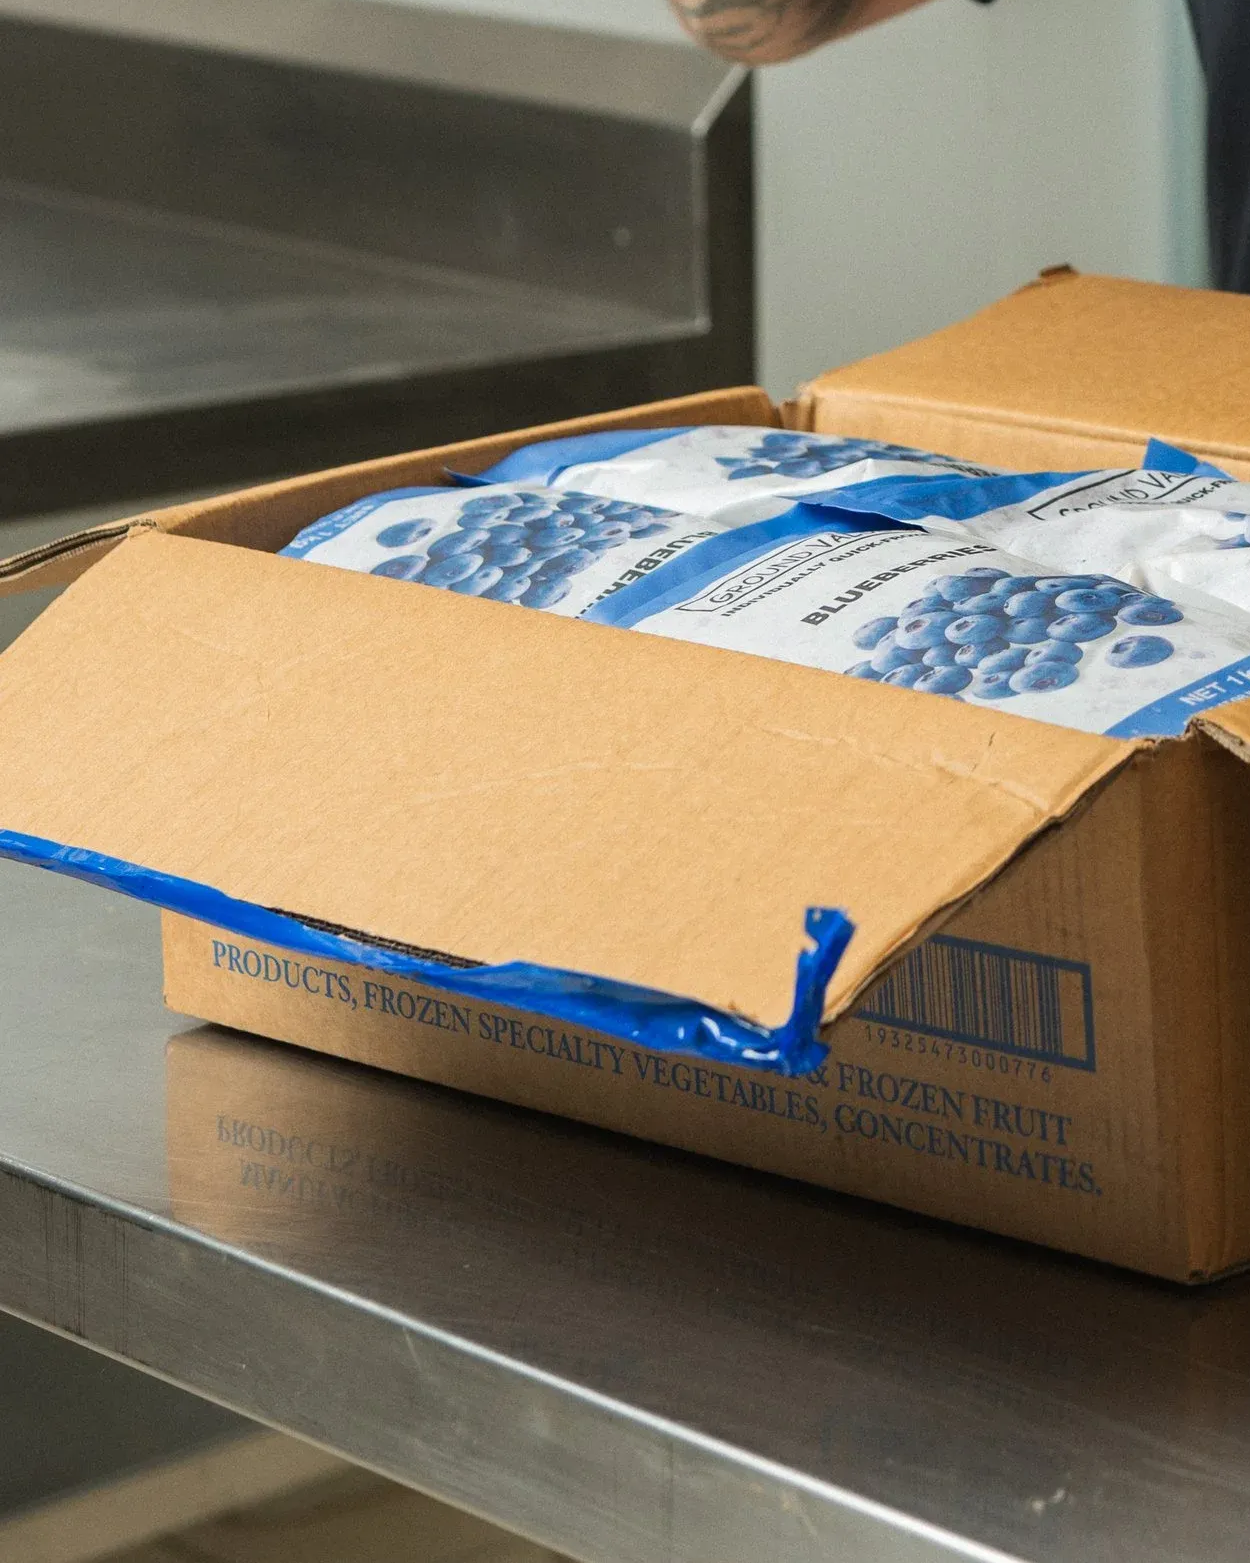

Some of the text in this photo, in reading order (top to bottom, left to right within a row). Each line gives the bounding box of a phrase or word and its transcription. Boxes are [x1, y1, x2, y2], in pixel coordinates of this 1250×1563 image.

[709, 550, 813, 604] GROUND
[721, 561, 826, 618] INDIVIDUALLY
[801, 544, 997, 626] BLUEBERRIES
[1179, 681, 1227, 706] NET
[1226, 675, 1244, 685] 1
[212, 940, 1103, 1195] PRODUCTS, FROZEN SPECIALTY VEGETABLES, CONCENTRATES.
[864, 1024, 1052, 1084] 19325473000776
[836, 1060, 966, 1121] FROZEN
[971, 1093, 1073, 1147] FRUIT
